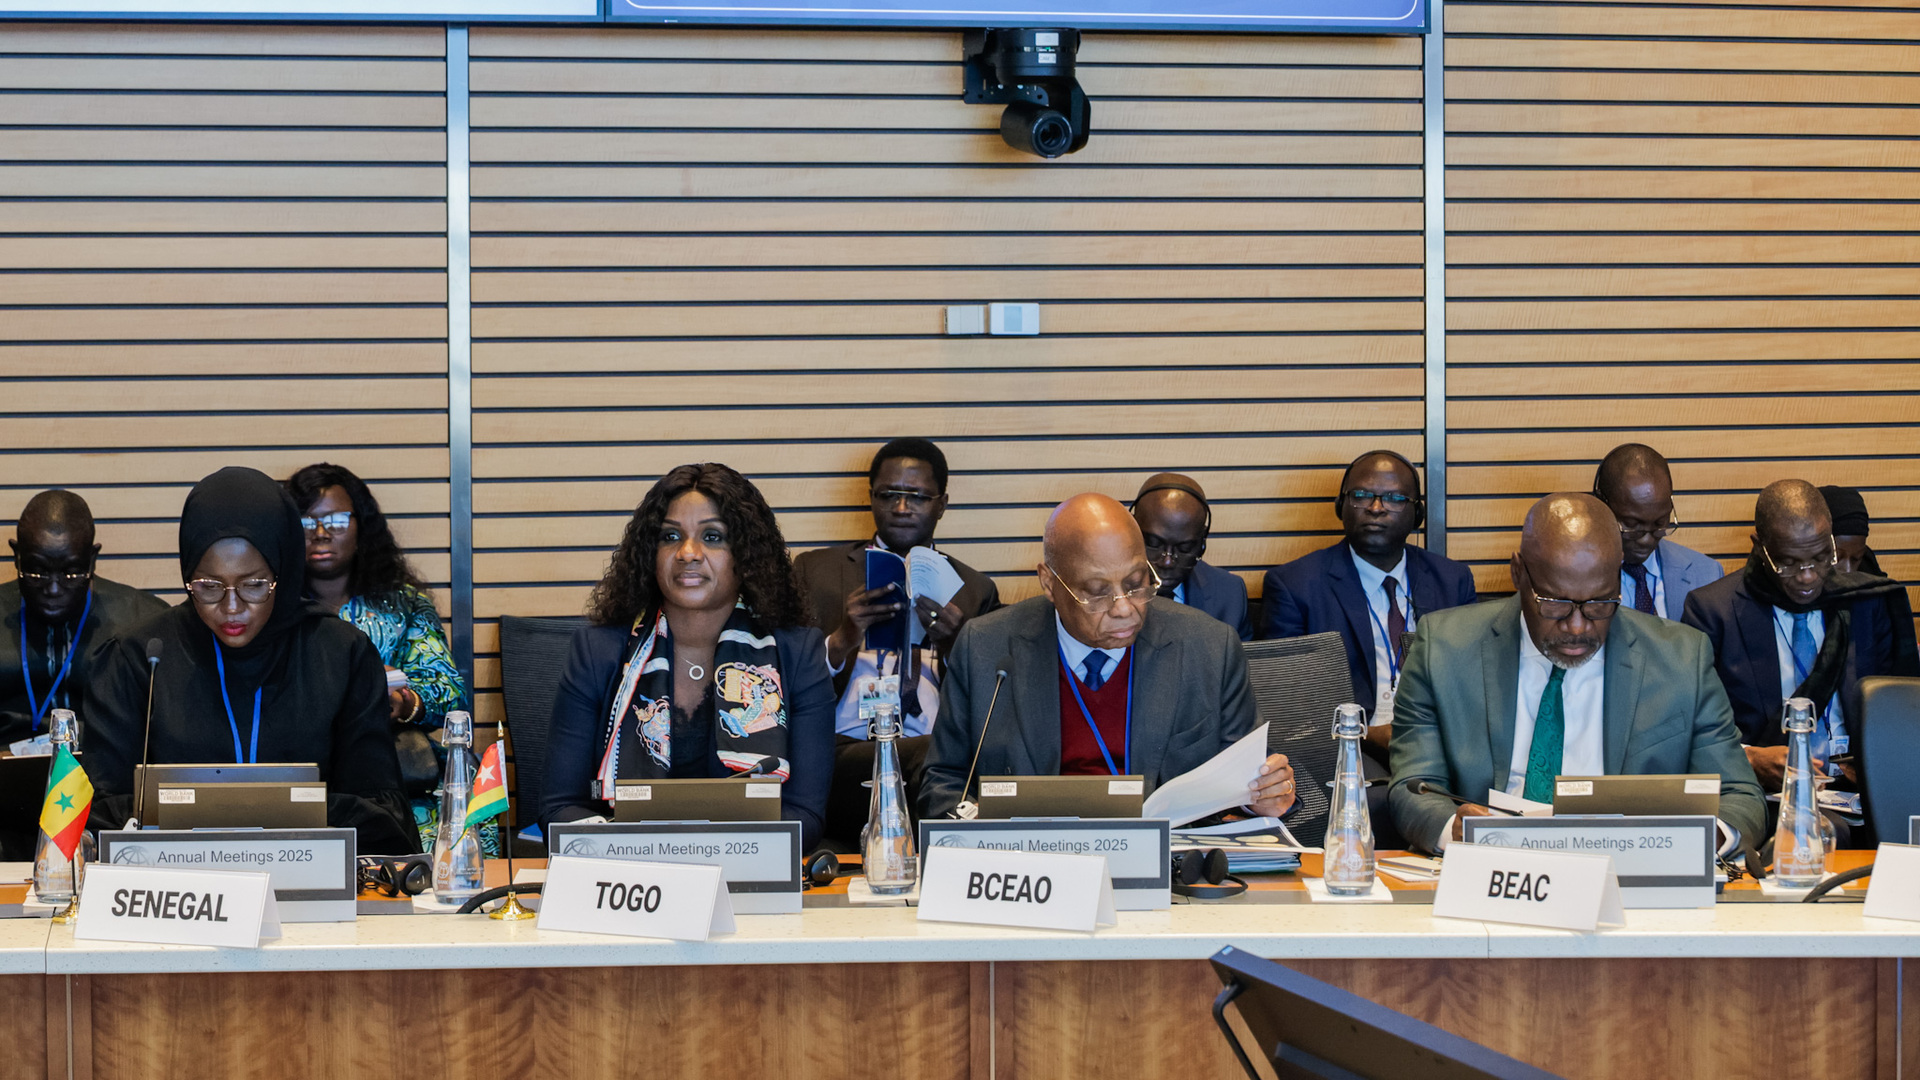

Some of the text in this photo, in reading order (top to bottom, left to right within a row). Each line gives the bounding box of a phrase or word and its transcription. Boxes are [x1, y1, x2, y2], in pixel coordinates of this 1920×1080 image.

[606, 842, 759, 857] Annual Meetings 2025
[977, 838, 1128, 854] Annual Meetings 2025
[1521, 836, 1673, 851] Annual Meetings 2025
[157, 849, 313, 865] Annual Meetings 2025
[596, 881, 661, 913] TOGO
[967, 872, 1052, 904] BCEAO
[1488, 870, 1550, 902] BEAC
[111, 888, 228, 922] SENEGAL
